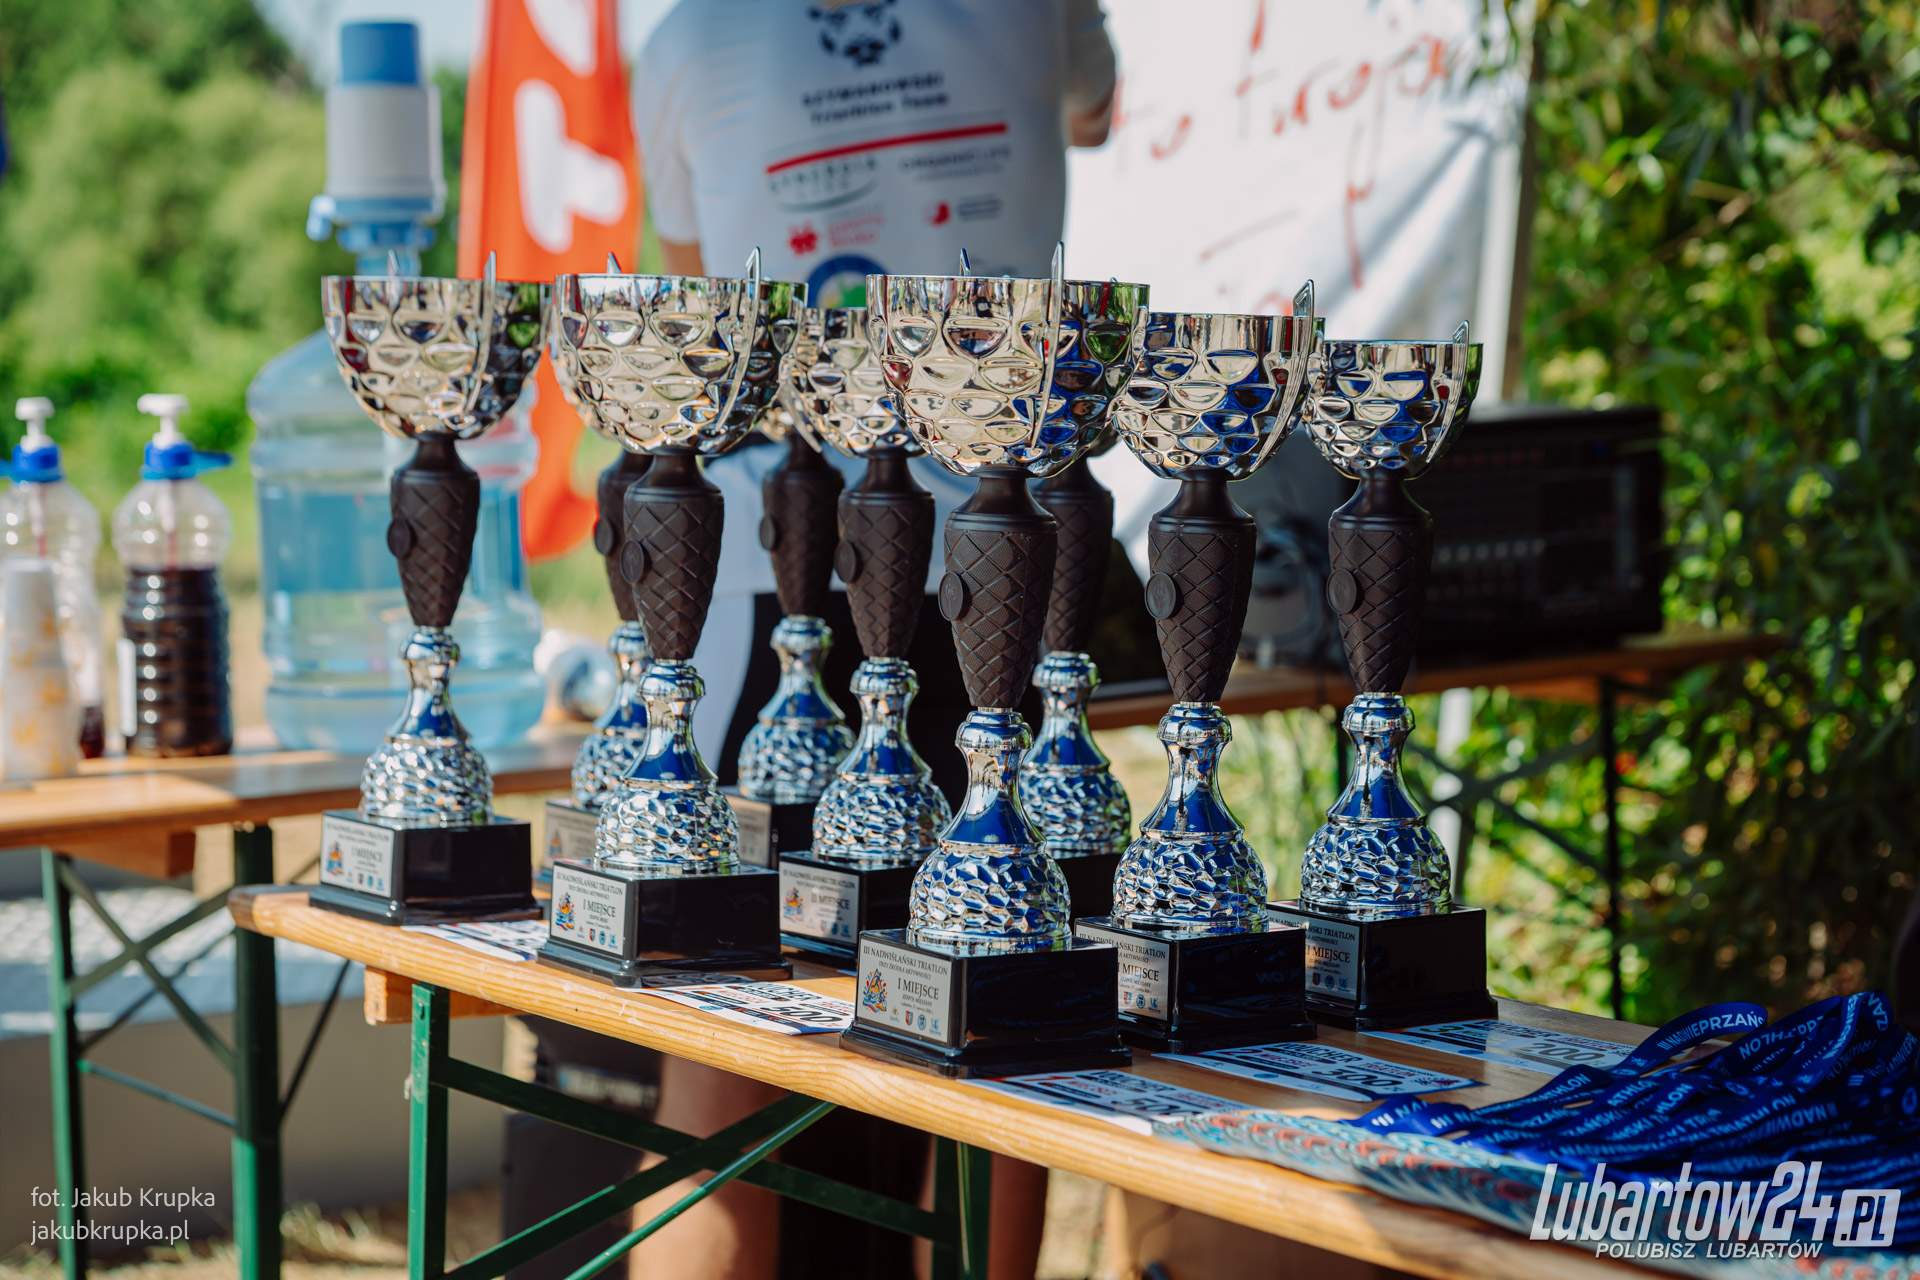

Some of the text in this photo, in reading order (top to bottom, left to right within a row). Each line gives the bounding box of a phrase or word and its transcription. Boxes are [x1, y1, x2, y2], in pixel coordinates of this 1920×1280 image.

[587, 900, 616, 918] MIEJSCE
[1324, 928, 1356, 942] TRIATLON
[1135, 945, 1166, 959] TRIATLON
[1313, 946, 1351, 964] MIEJSCE
[917, 960, 948, 976] TRIATLON
[1122, 963, 1160, 981] MIEJSCE
[902, 979, 939, 1001] MIEJSCE
[760, 1006, 843, 1023] 500
[1273, 1042, 1363, 1063] VOUCHER
[1519, 1042, 1605, 1062] 200
[1312, 1067, 1402, 1087] 300
